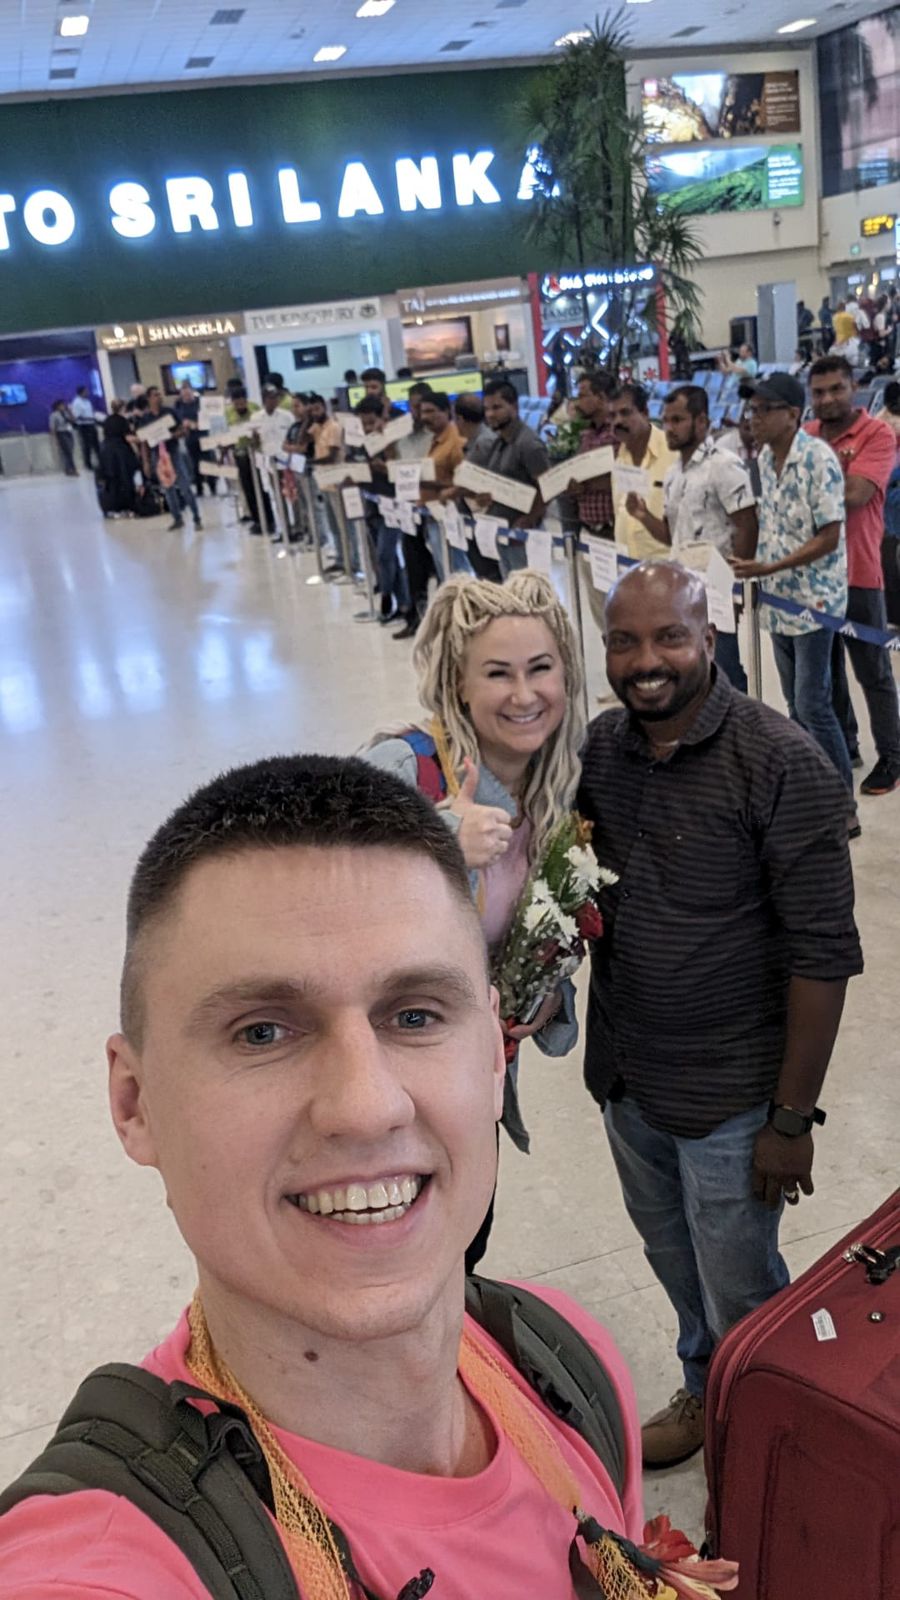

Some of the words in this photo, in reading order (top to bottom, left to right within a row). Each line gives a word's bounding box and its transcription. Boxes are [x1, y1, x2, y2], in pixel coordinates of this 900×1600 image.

[0, 189, 76, 251] TO
[109, 172, 254, 239] SRI
[278, 144, 561, 223] LANKA
[148, 318, 236, 341] SHANGRI-LA
